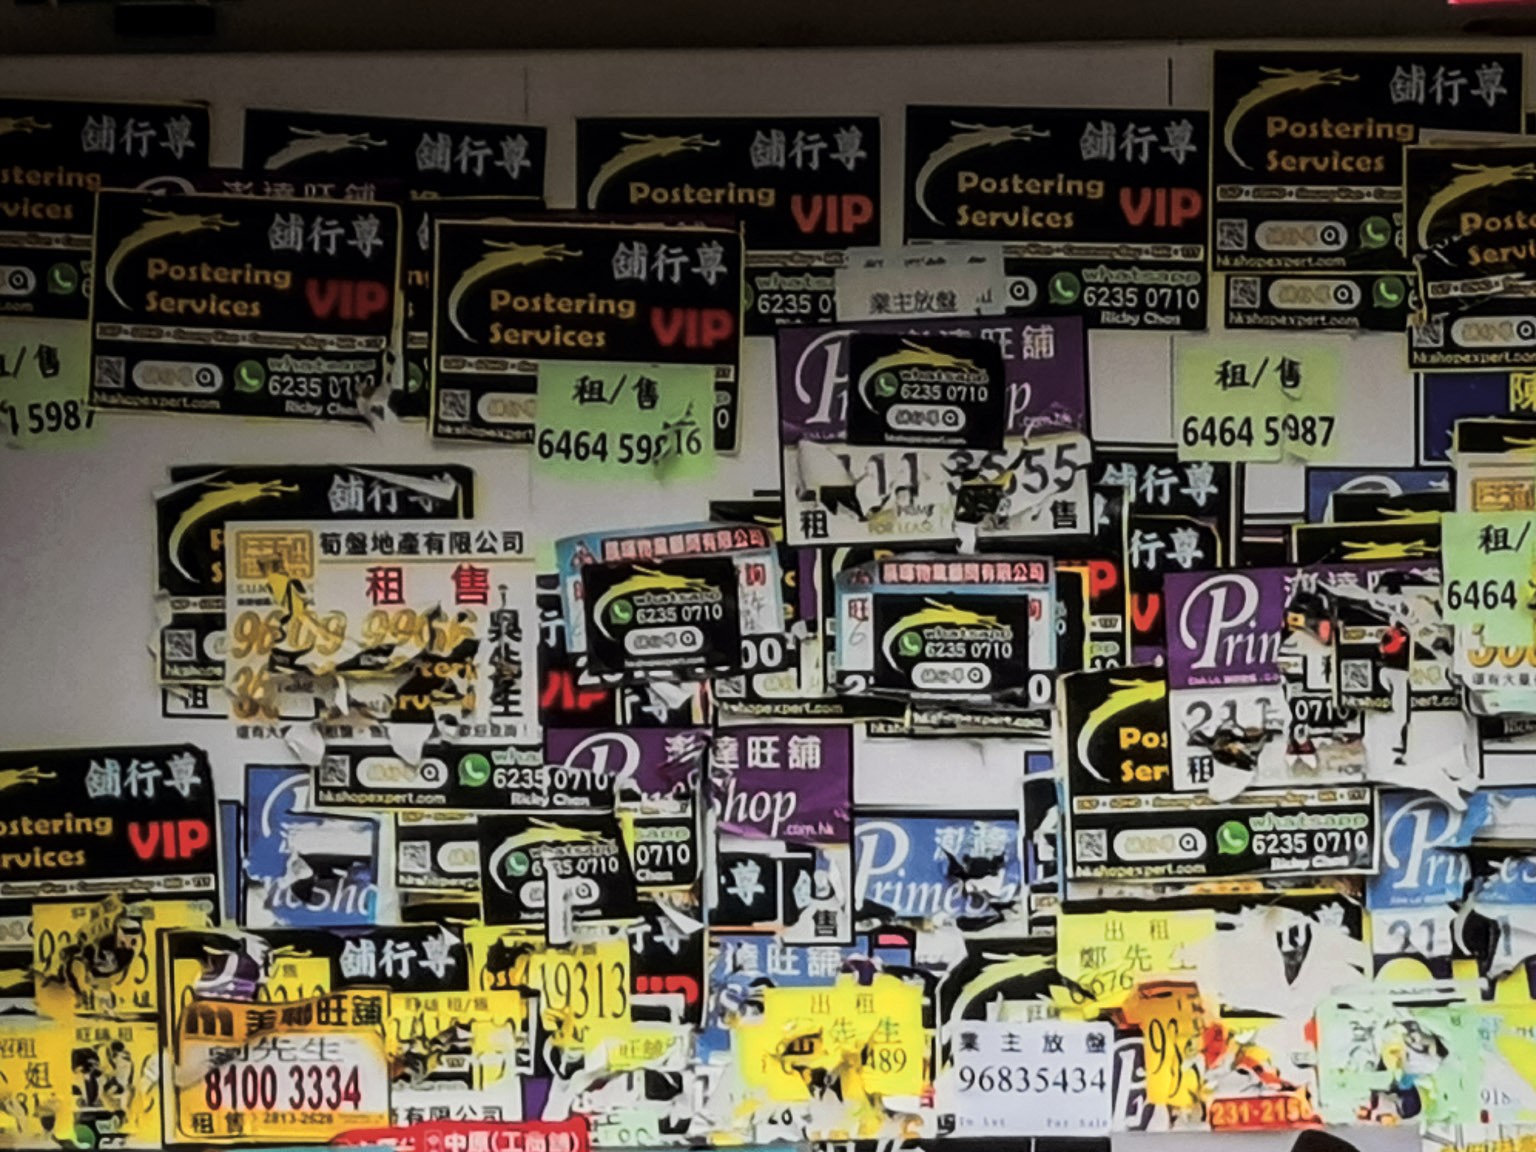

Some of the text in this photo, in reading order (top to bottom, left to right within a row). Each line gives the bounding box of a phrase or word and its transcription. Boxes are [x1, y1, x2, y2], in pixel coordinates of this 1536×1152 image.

[1266, 116, 1417, 143] Postering
[1266, 151, 1385, 173] Services
[628, 181, 776, 208] Postering
[956, 170, 1105, 199] Postering
[790, 194, 875, 235] VIP
[956, 204, 1074, 228] Services
[1119, 186, 1202, 228] VIP
[145, 256, 293, 290] Postering
[145, 290, 262, 320] Services
[304, 278, 390, 320] VIP
[489, 289, 638, 320] Postering
[1083, 288, 1199, 309] 6235 0710
[489, 324, 607, 349] Services
[649, 307, 734, 349] VIP
[901, 385, 988, 401] 6235 0710
[1183, 415, 1335, 447] 6464 5987
[538, 429, 608, 464] 6464
[800, 510, 829, 540] 租
[365, 564, 490, 606] 租 售
[1448, 581, 1516, 611] 6464
[637, 604, 722, 623] 6235 0710
[925, 643, 1012, 658] 6235 0710
[494, 769, 609, 790] 6235 0710
[1249, 814, 1368, 832] whatsapp
[128, 819, 209, 860] VIP
[1252, 833, 1368, 854] 6235 0710
[960, 1032, 1107, 1053] 業主放盤
[205, 1065, 361, 1111] 8100 3334
[959, 1066, 1107, 1093] 96835434
